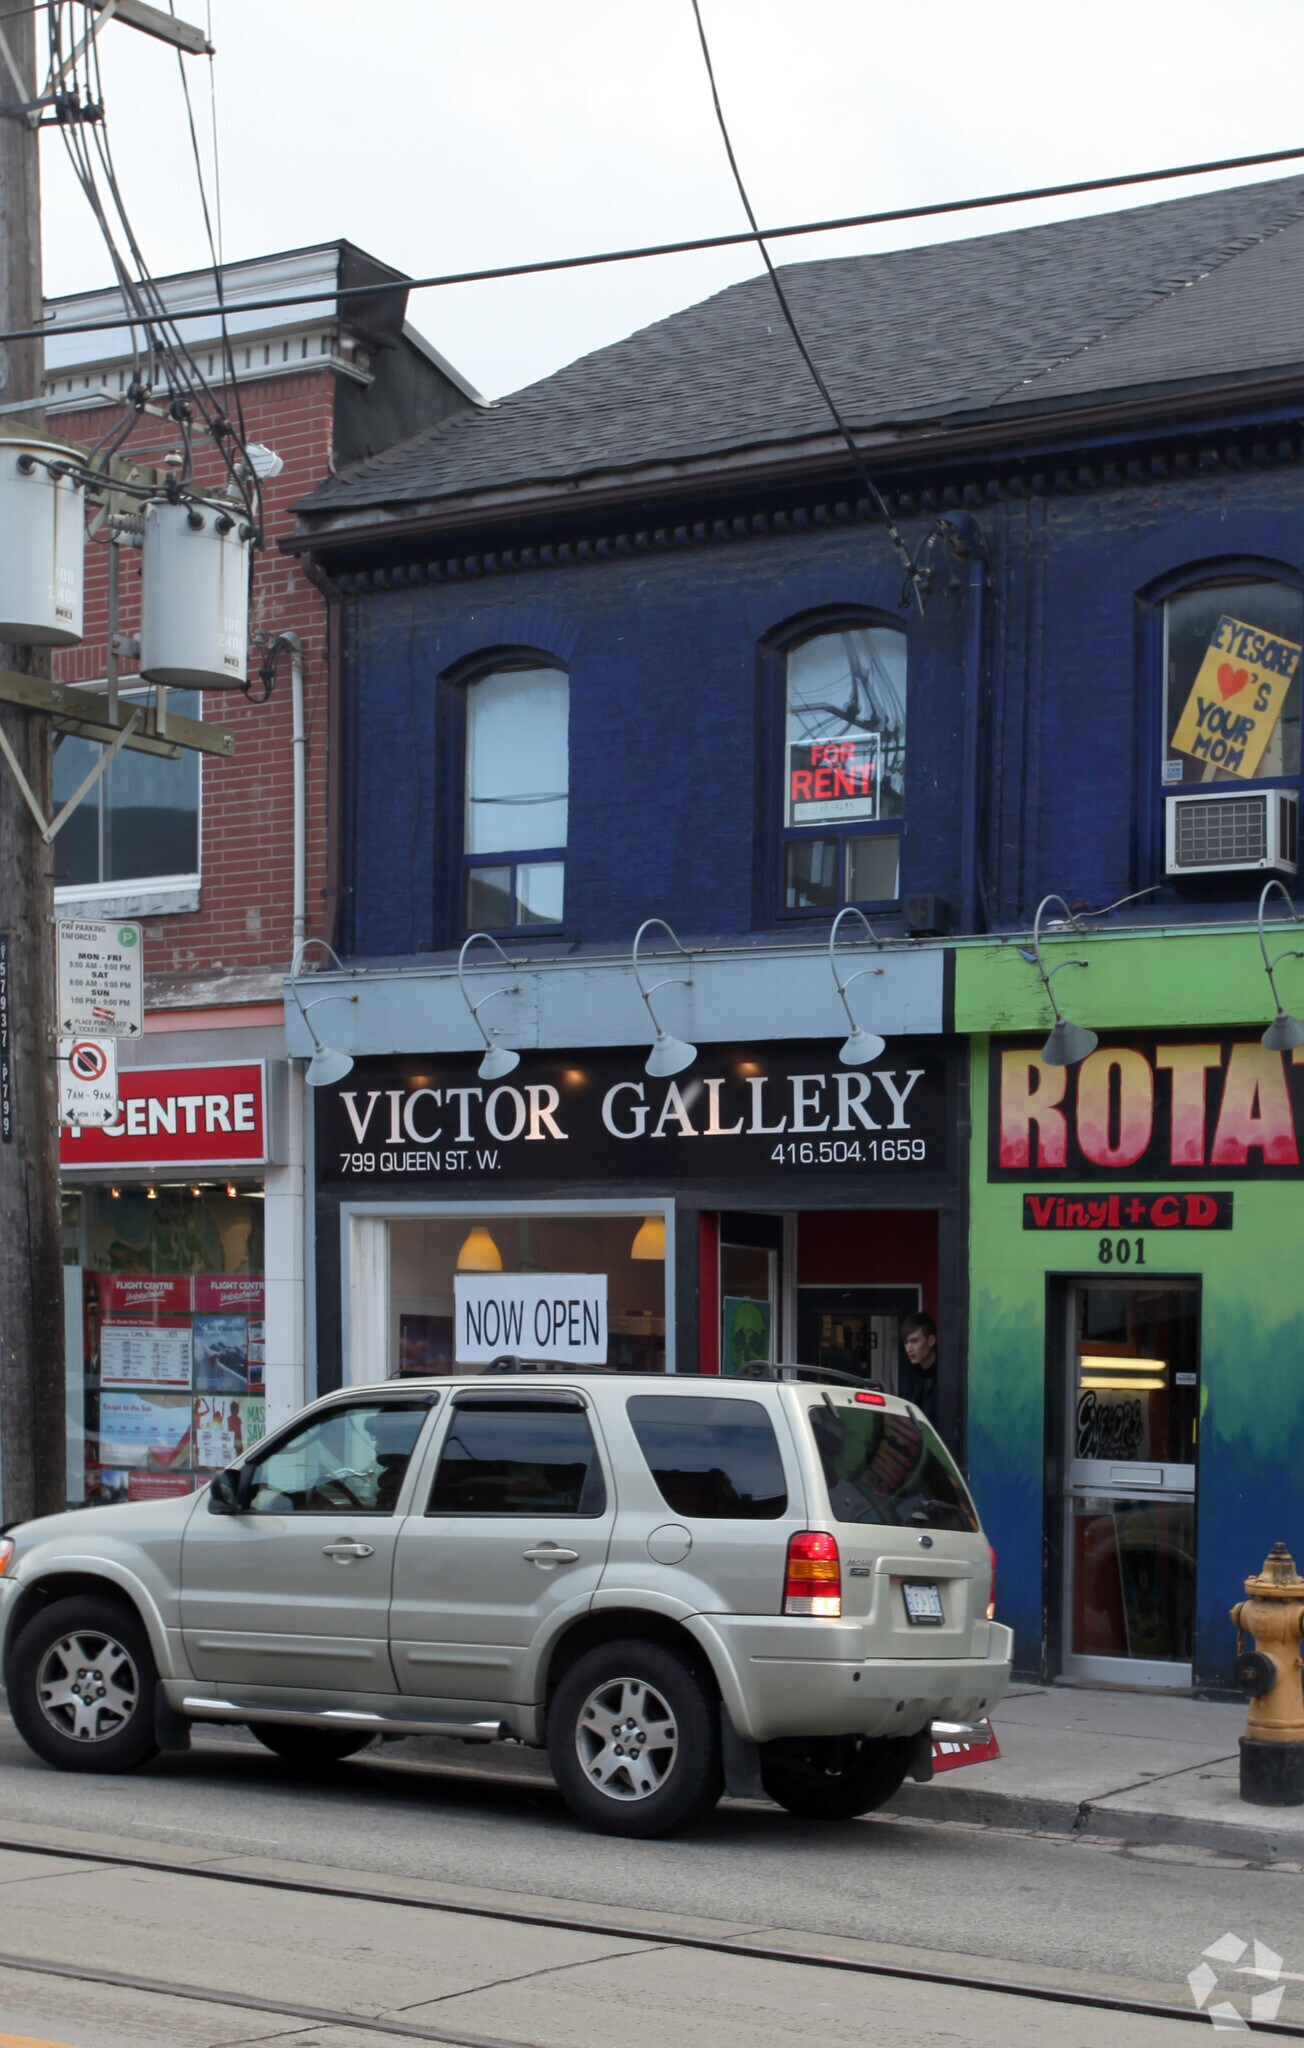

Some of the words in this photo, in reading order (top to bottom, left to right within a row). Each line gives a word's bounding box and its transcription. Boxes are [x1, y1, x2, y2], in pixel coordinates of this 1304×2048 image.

[1210, 618, 1300, 678] EYESORE
[1196, 697, 1255, 746] YOUR
[811, 742, 856, 766] FOR
[1191, 733, 1245, 772] MOM
[791, 763, 875, 801] RENT
[61, 923, 73, 931] PAY
[75, 924, 106, 933] PARKING
[61, 932, 98, 941] ENFORCED
[91, 971, 108, 979] SAT
[91, 989, 110, 997] SUN
[339, 1085, 568, 1144] VICTOR
[602, 1070, 926, 1139] GALLERY
[340, 1153, 375, 1173] 799
[380, 1153, 441, 1172] QUEEN
[445, 1152, 473, 1171] ST.
[476, 1151, 502, 1170] W.
[771, 1140, 926, 1165] 416.504.1659
[1098, 1238, 1147, 1264] 801
[116, 1281, 143, 1291] FLIGHT
[144, 1281, 174, 1291] CENTRE
[210, 1281, 238, 1291] FLIGHT
[464, 1300, 524, 1348] NOW
[533, 1299, 600, 1347] OPEN
[103, 1403, 121, 1412] Escape
[130, 1404, 139, 1412] the
